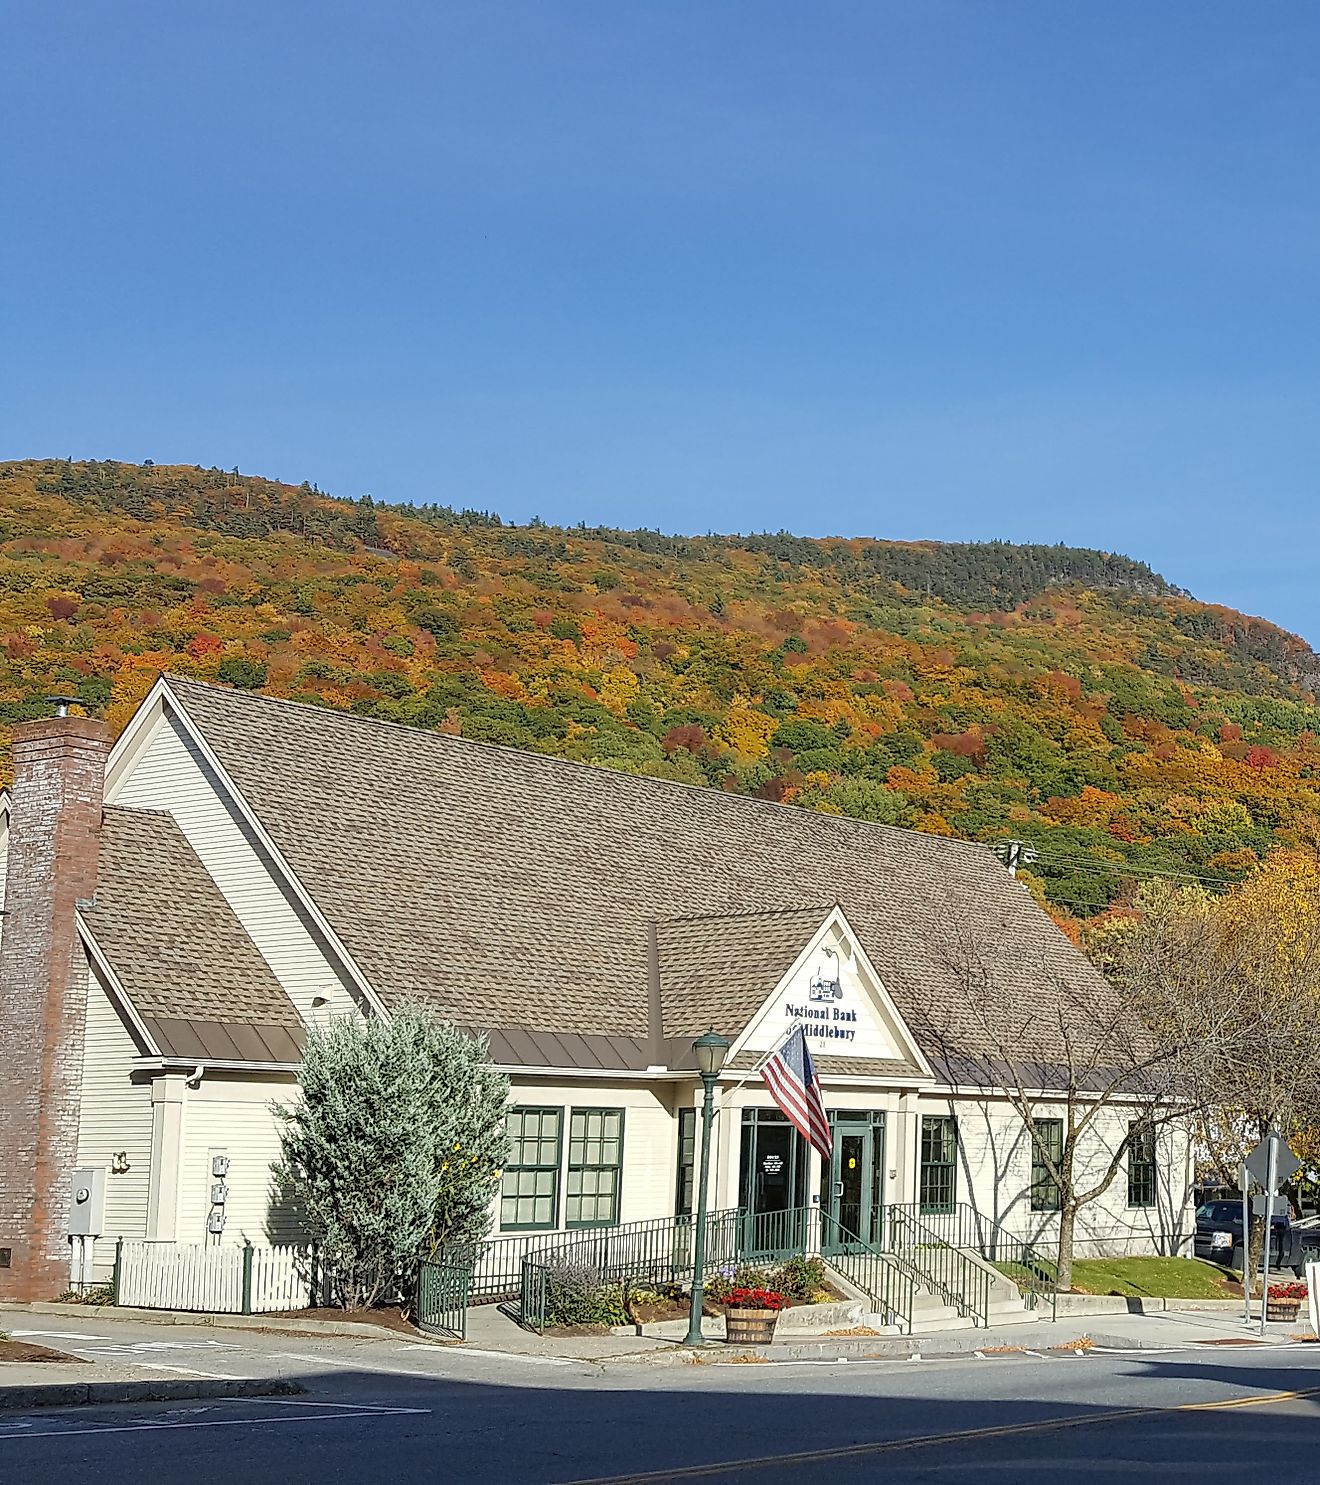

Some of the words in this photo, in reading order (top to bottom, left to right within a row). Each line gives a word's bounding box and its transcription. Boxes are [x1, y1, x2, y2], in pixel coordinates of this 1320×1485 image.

[785, 1003, 830, 1020] National
[832, 1008, 857, 1022] Bank
[802, 1024, 855, 1042] Middlebury
